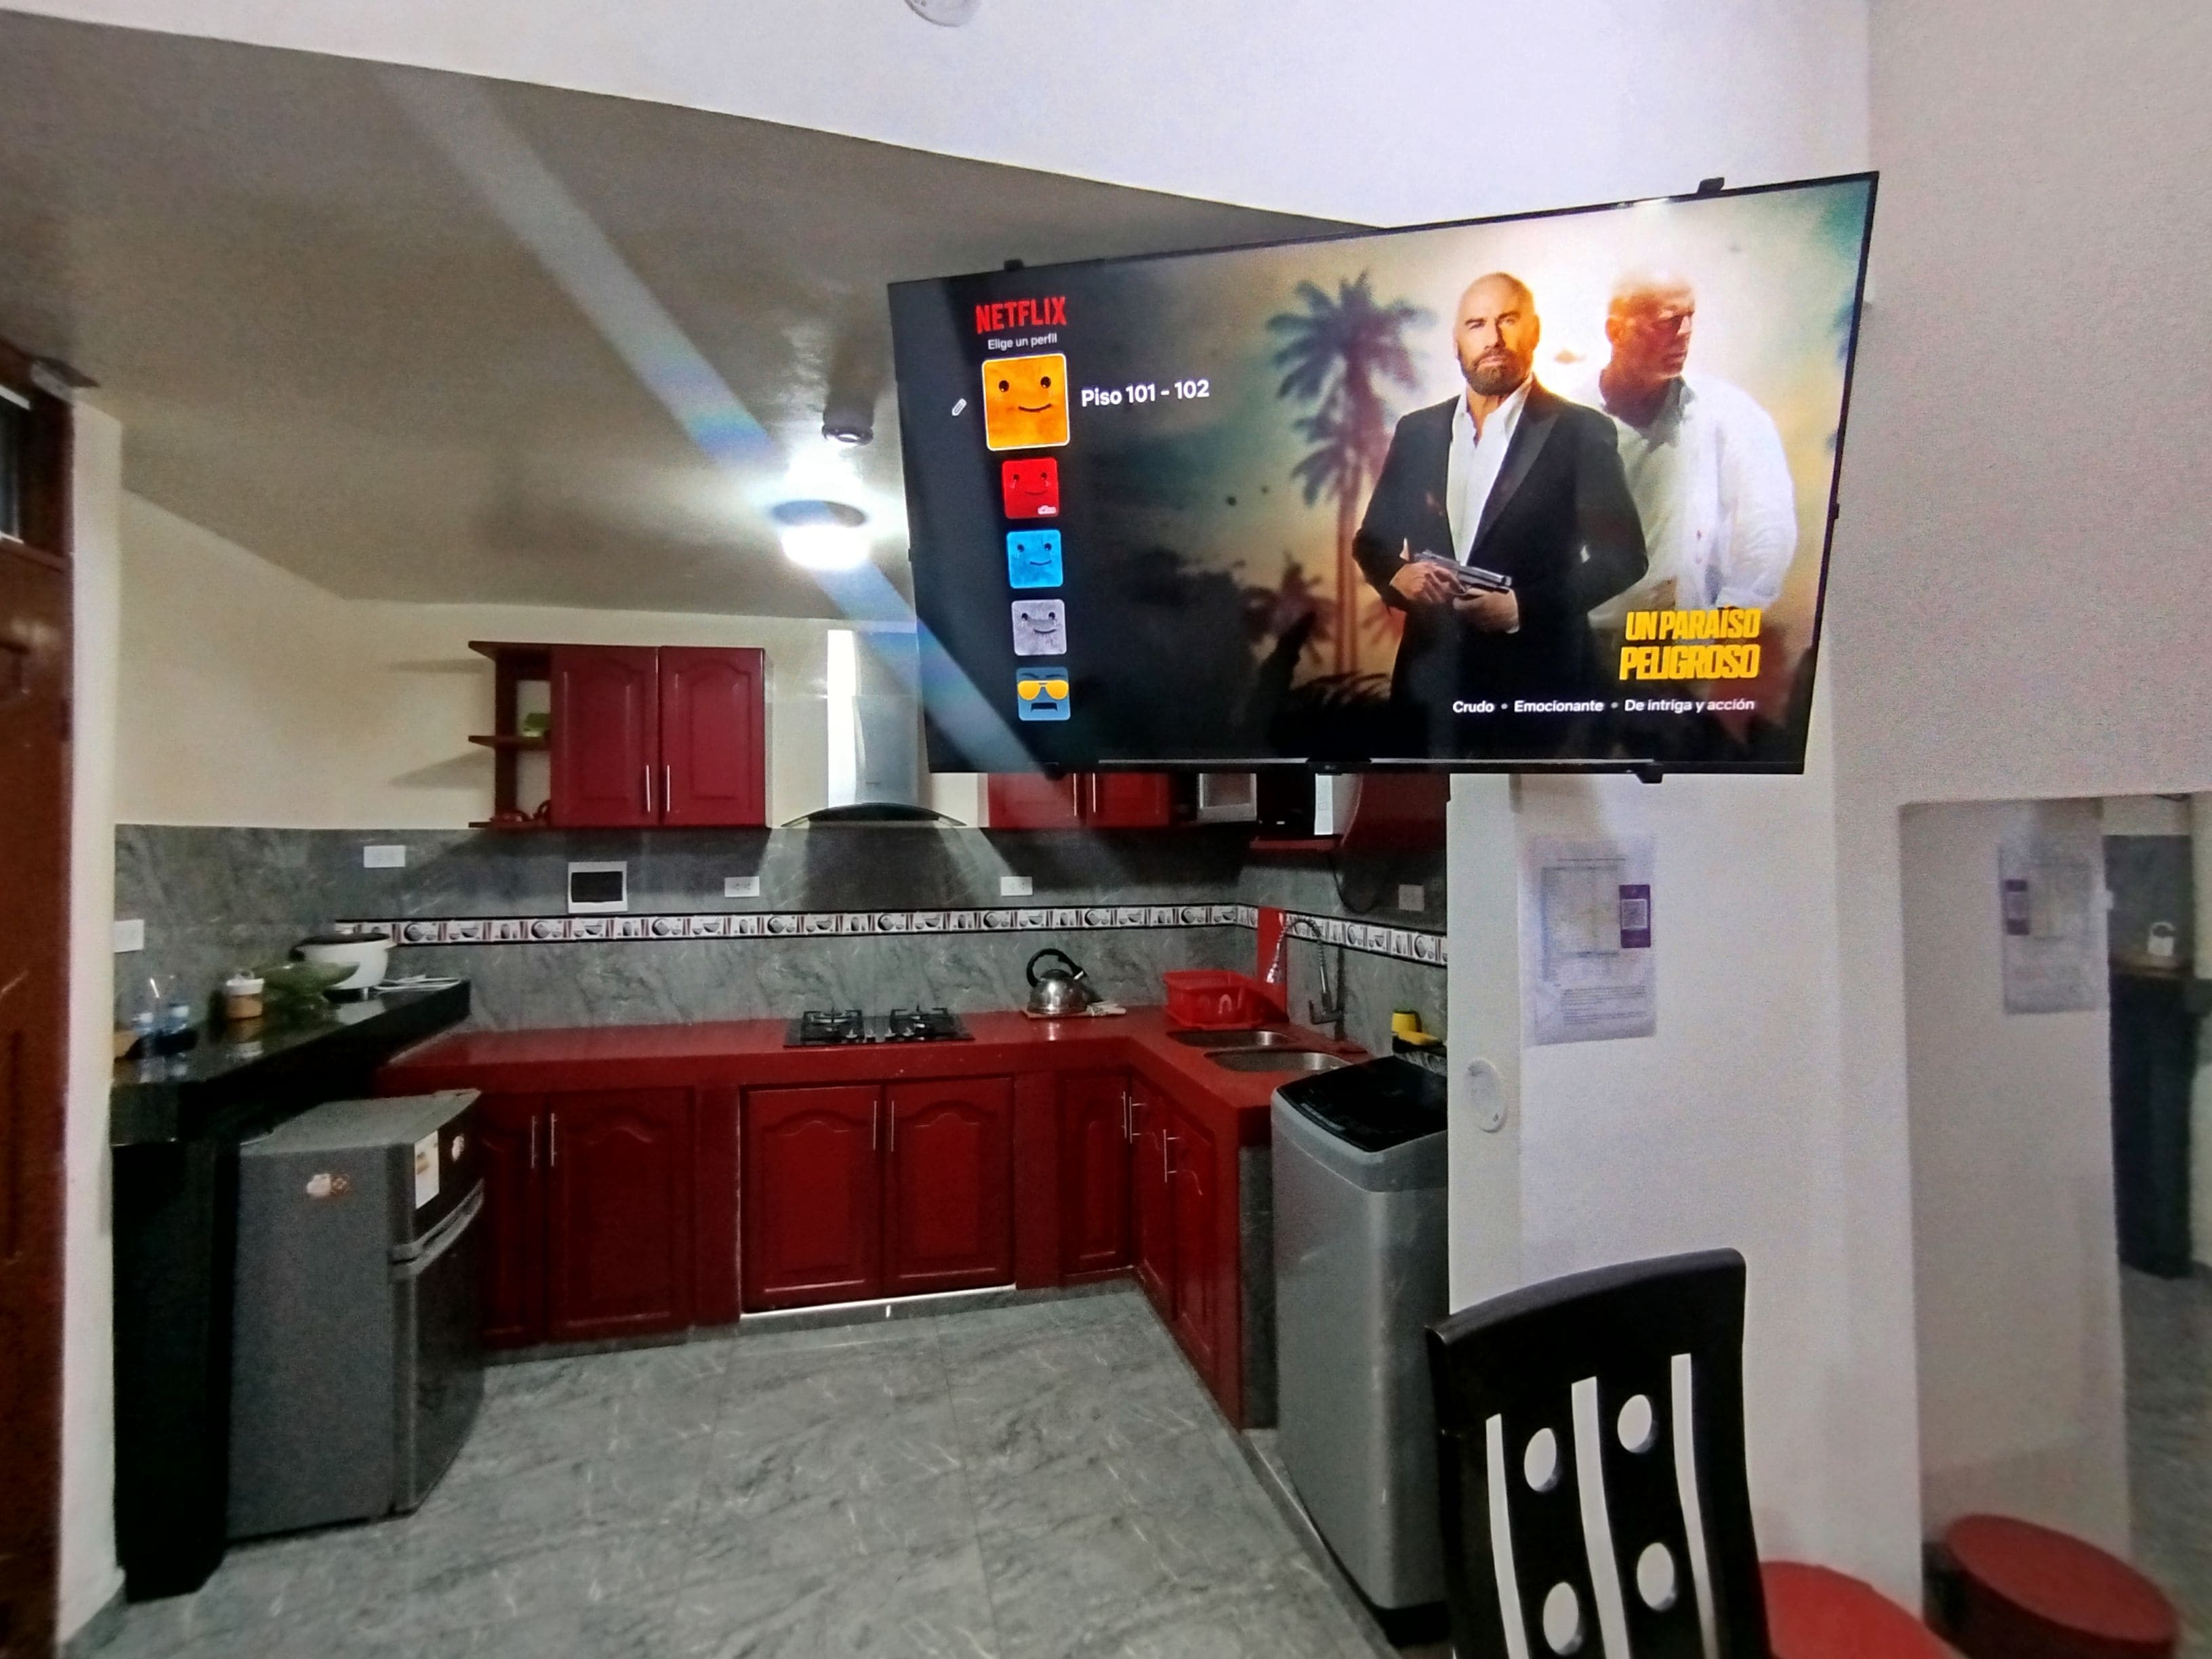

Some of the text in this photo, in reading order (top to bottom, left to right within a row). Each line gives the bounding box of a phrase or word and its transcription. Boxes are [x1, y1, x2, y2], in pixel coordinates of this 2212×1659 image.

[975, 296, 1067, 334] NETFLIX
[987, 333, 1057, 351] Elige un perfil
[1081, 387, 1122, 407] Piso
[1125, 384, 1155, 403] 101
[1174, 379, 1210, 399] 102
[1625, 604, 1762, 640] UN PARAÍSO
[1619, 644, 1761, 680] PELIGROSO
[1452, 697, 1755, 714] Crudo Emocionante De intriga y acción
